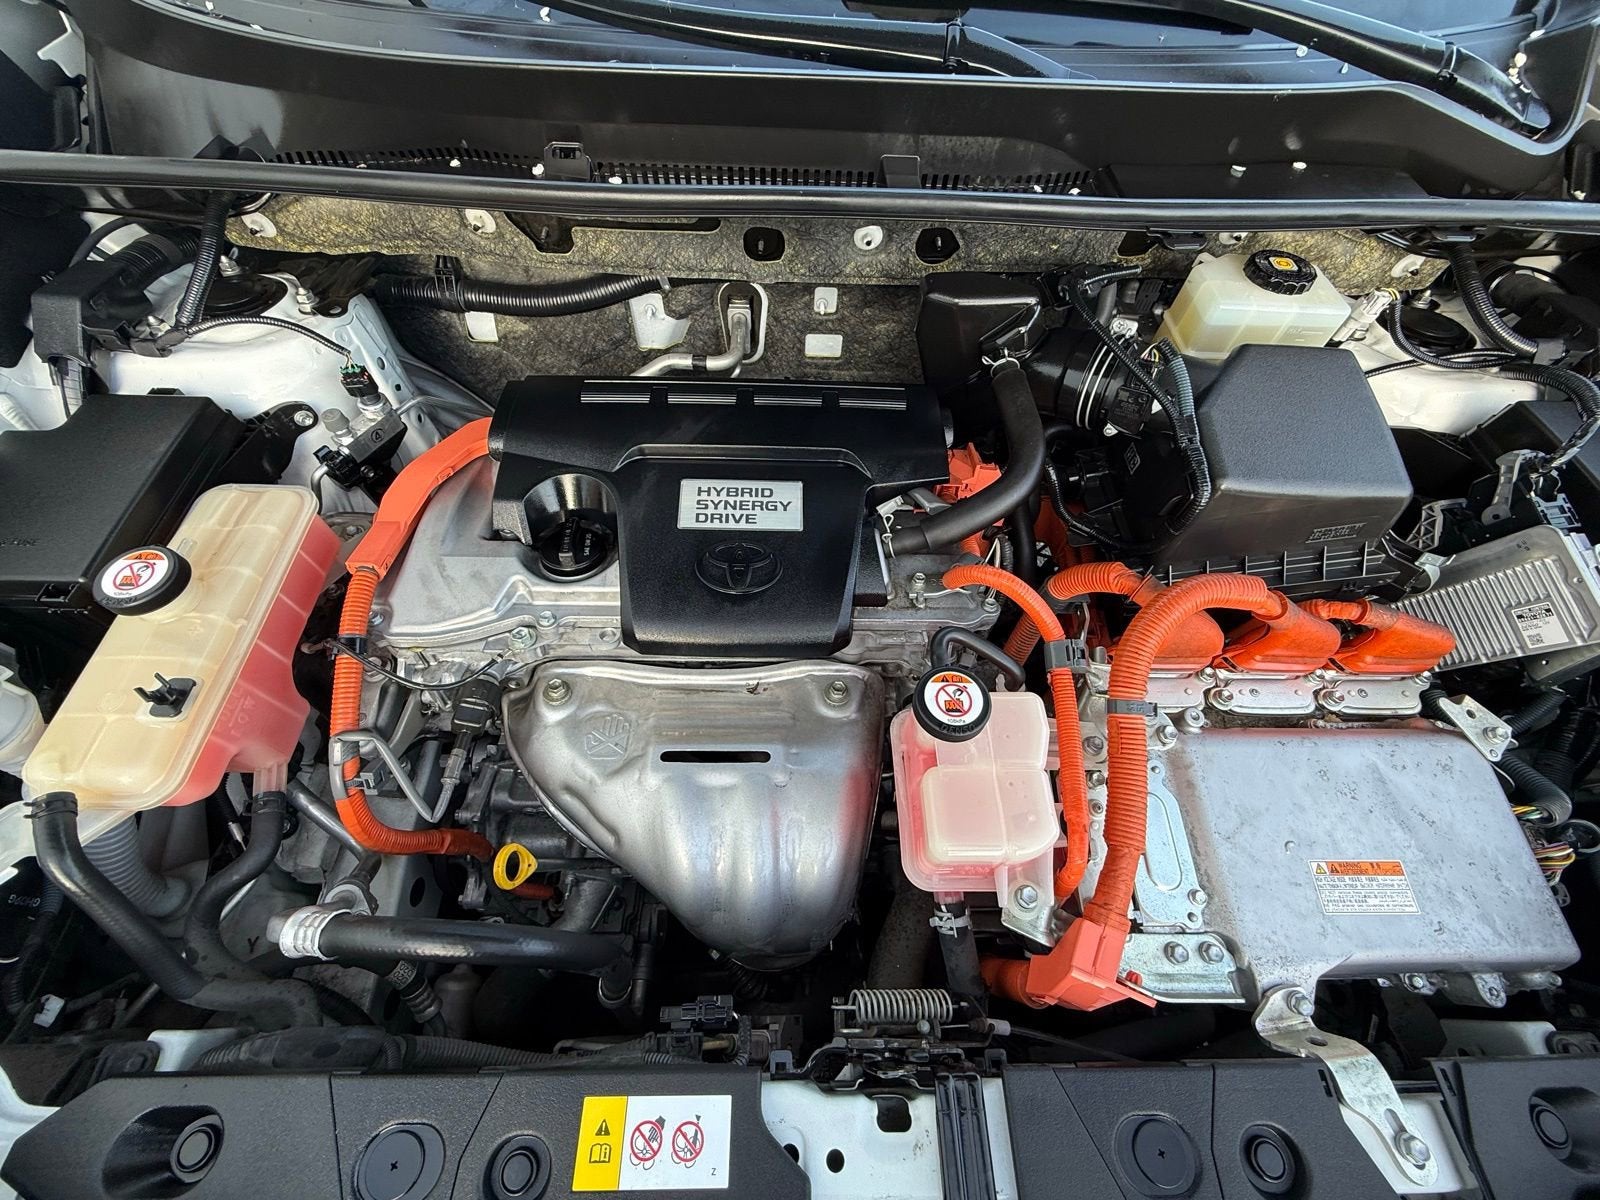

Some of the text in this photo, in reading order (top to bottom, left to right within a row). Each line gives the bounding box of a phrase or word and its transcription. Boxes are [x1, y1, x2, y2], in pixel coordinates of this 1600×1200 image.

[697, 486, 774, 498] HYBRID
[695, 499, 793, 512] SYNERGY
[695, 512, 758, 525] DRIVE
[939, 724, 976, 735] DENSO
